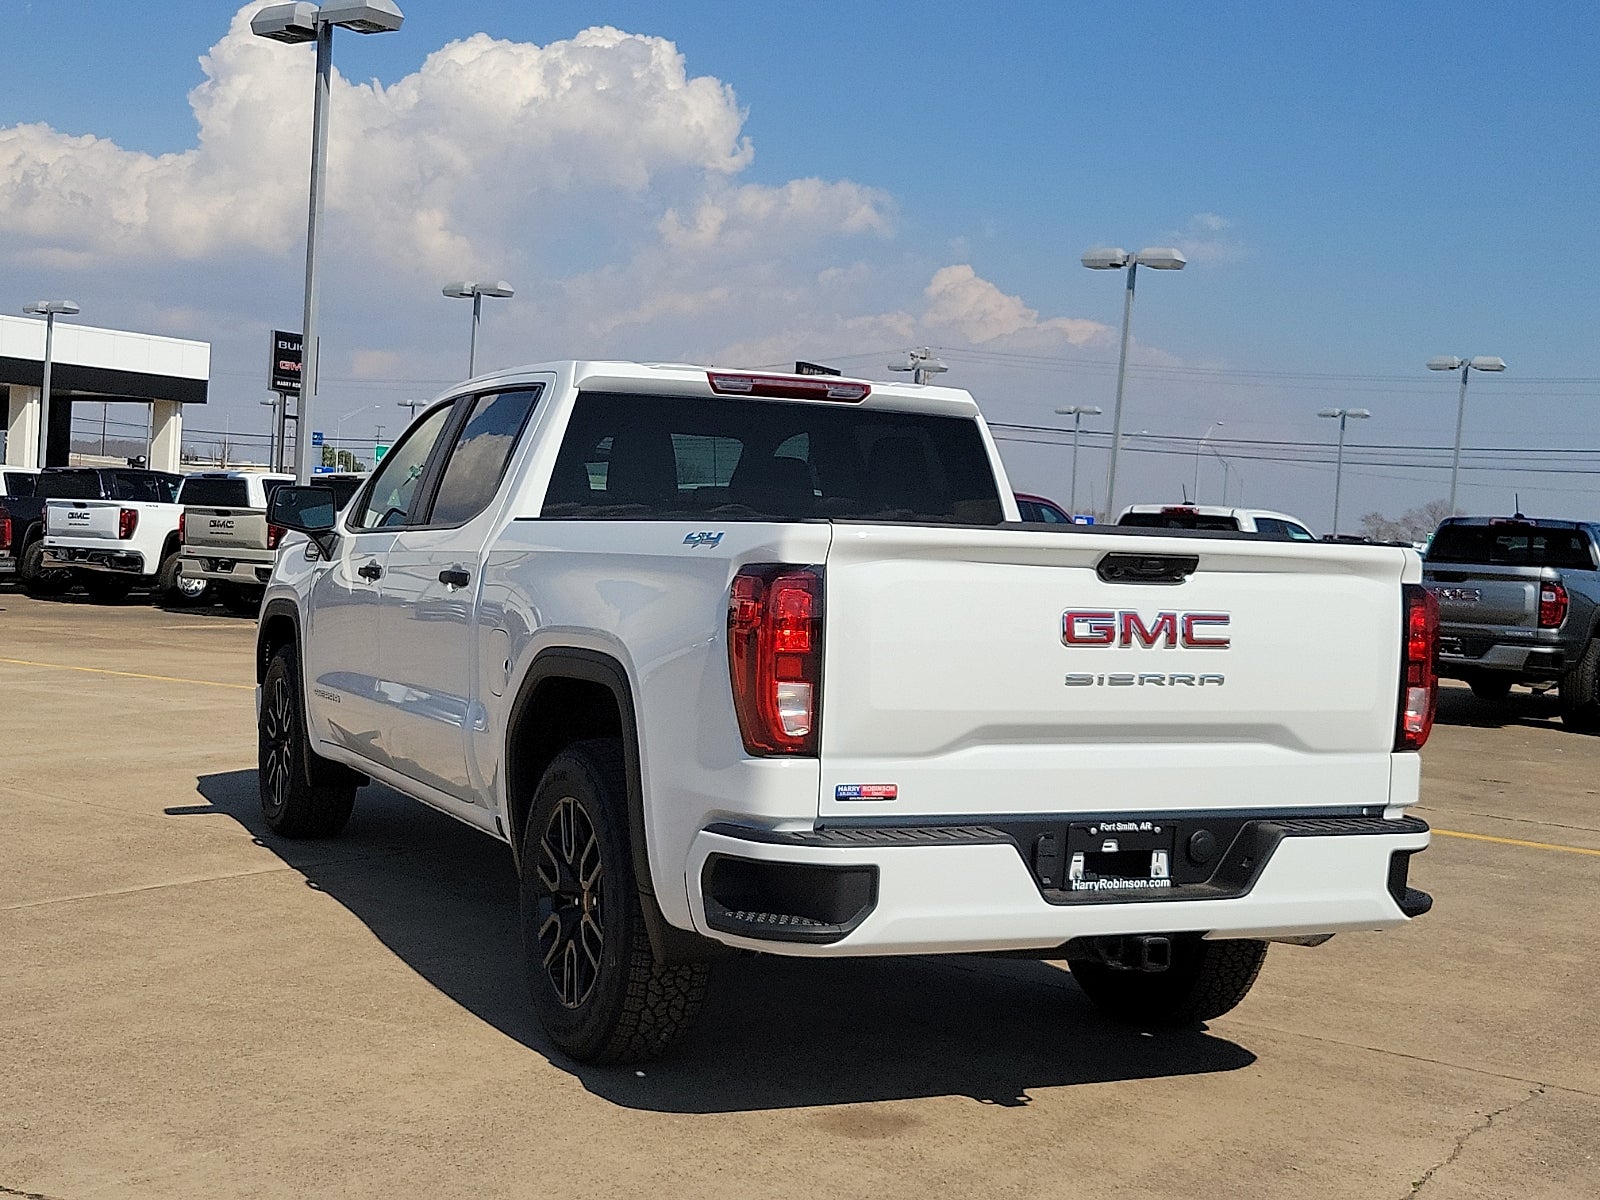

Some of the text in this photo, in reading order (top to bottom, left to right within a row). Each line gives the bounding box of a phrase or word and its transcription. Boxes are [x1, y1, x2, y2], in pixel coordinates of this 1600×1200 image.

[278, 340, 304, 351] BUI
[279, 360, 303, 372] GM
[67, 511, 90, 520] GMC
[209, 519, 235, 529] GMC
[1060, 606, 1232, 650] GMC
[1064, 673, 1226, 687] SIERRA
[1100, 821, 1153, 832] Fort Smith, AR
[1072, 878, 1171, 891] HarryRobinson.com
